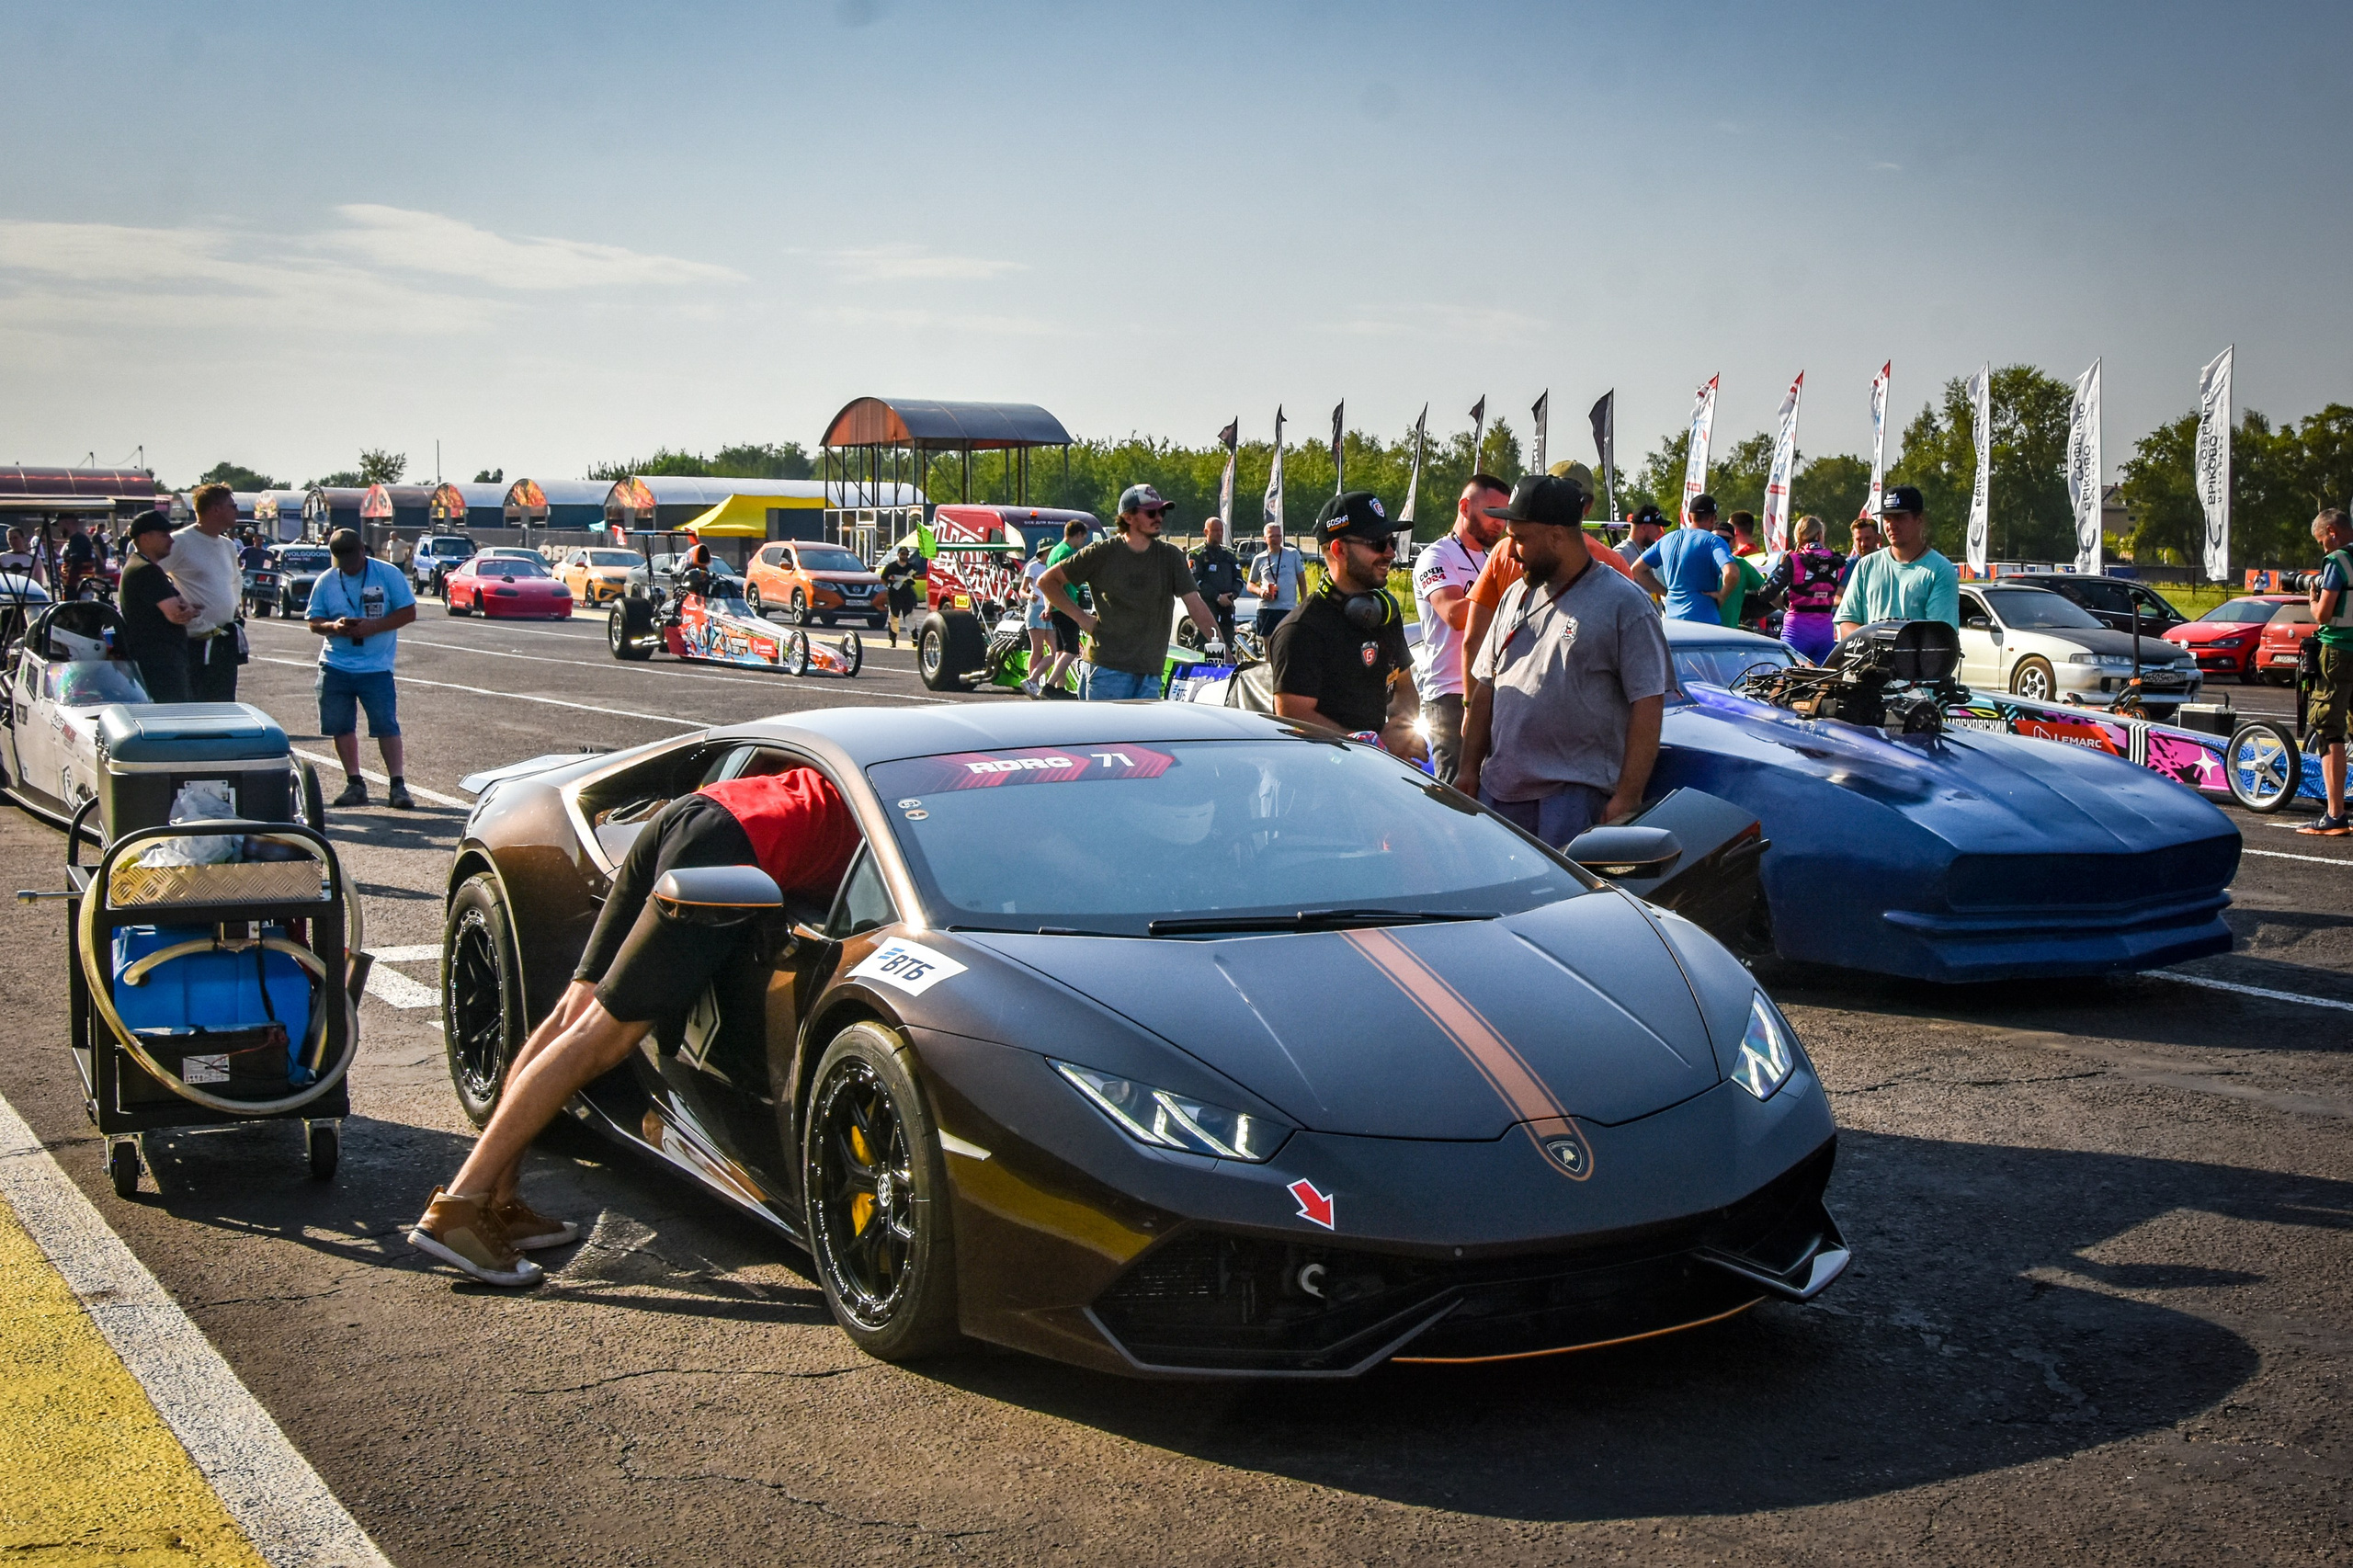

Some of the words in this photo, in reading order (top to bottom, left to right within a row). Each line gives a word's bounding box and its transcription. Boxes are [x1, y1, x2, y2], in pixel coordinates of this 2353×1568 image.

[1326, 515, 1349, 528] GOSHA
[1419, 566, 1445, 582] СОЧИ
[1421, 574, 1447, 589] 2024
[1366, 650, 1373, 662] G
[2054, 733, 2102, 749] LEMARC
[965, 756, 1074, 775] RDRC
[1090, 752, 1136, 767] 71
[879, 954, 937, 981] ВТБ
